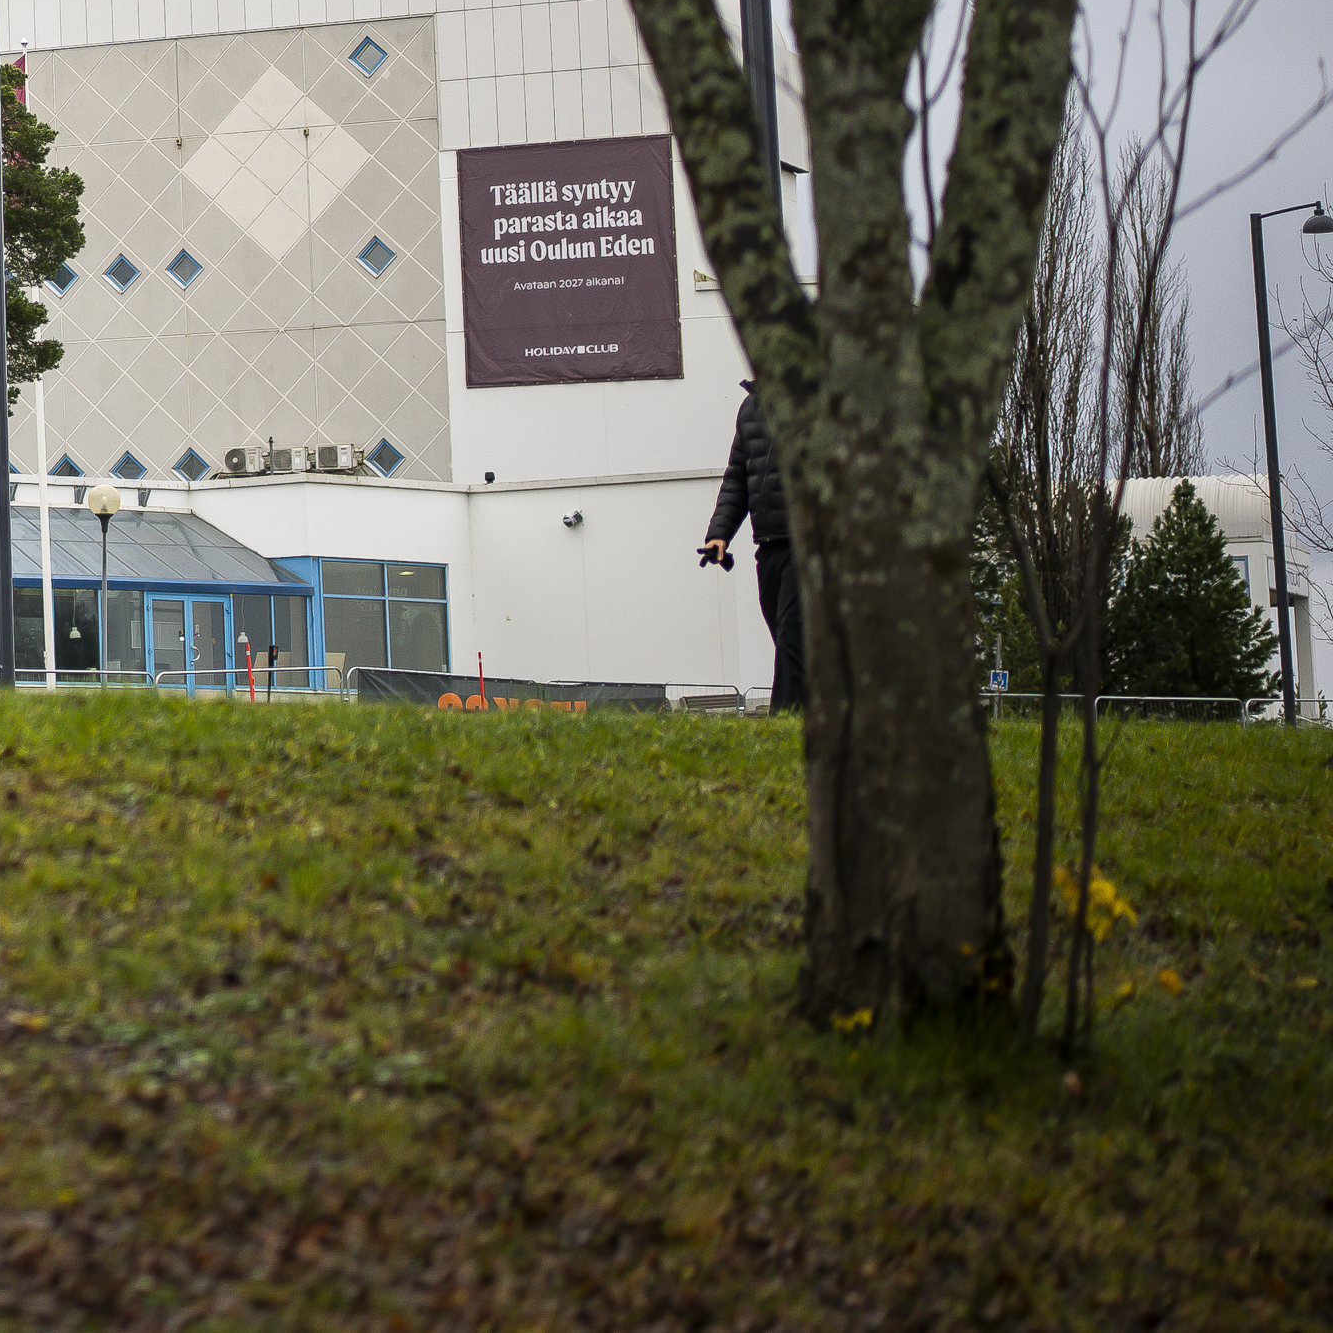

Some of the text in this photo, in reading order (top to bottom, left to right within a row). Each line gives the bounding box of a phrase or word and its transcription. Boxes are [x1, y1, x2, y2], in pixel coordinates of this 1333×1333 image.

[489, 178, 636, 206] Täällä syntyy
[494, 205, 643, 240] parasta aikaa
[480, 233, 655, 265] uusi Oulun Eden
[513, 275, 625, 291] Avataan 2027 aikana!
[524, 343, 619, 357] HOLIDAY CLUB
